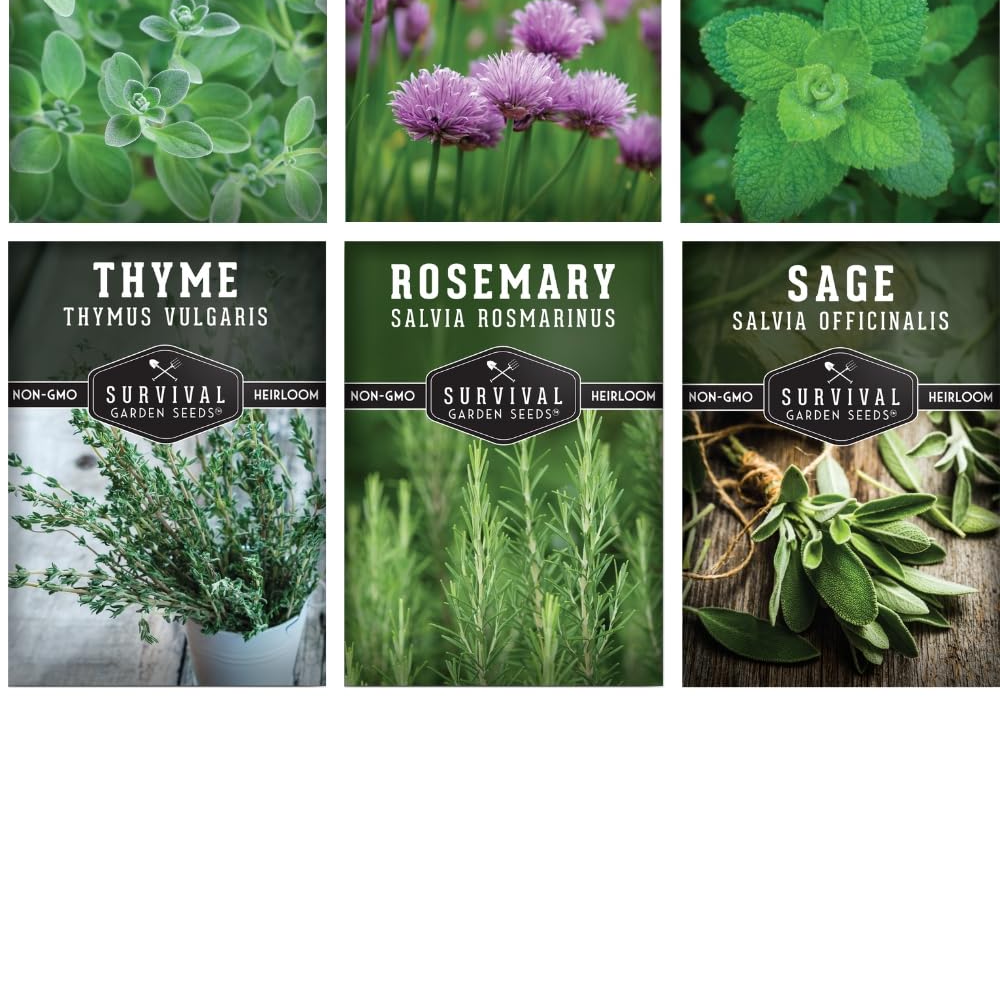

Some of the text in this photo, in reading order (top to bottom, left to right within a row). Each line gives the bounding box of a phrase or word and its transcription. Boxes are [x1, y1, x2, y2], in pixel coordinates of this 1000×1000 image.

[93, 262, 237, 297] THYME
[391, 264, 615, 299] ROSEMARY
[788, 265, 893, 302] SAGE
[64, 307, 267, 326] THYMUS VULGARIS
[392, 309, 614, 327] SALVIA ROSMARINUS
[733, 312, 948, 330] SALVIA OFFICINALIS
[13, 389, 77, 400] NON-GMO
[107, 386, 225, 403] SURVIVAL
[255, 389, 318, 400] HEIRLOOM
[351, 391, 415, 401] NON-GMO
[444, 387, 562, 404] SURVIVAL
[592, 391, 655, 401] HEIRLOOM
[690, 392, 752, 402] NON-GMO
[782, 388, 900, 405] SURVIVAL
[929, 392, 992, 402] HEIRLOOM
[111, 408, 164, 418] GARDEN
[449, 409, 501, 419] GARDEN
[787, 410, 839, 420] GARDEN
